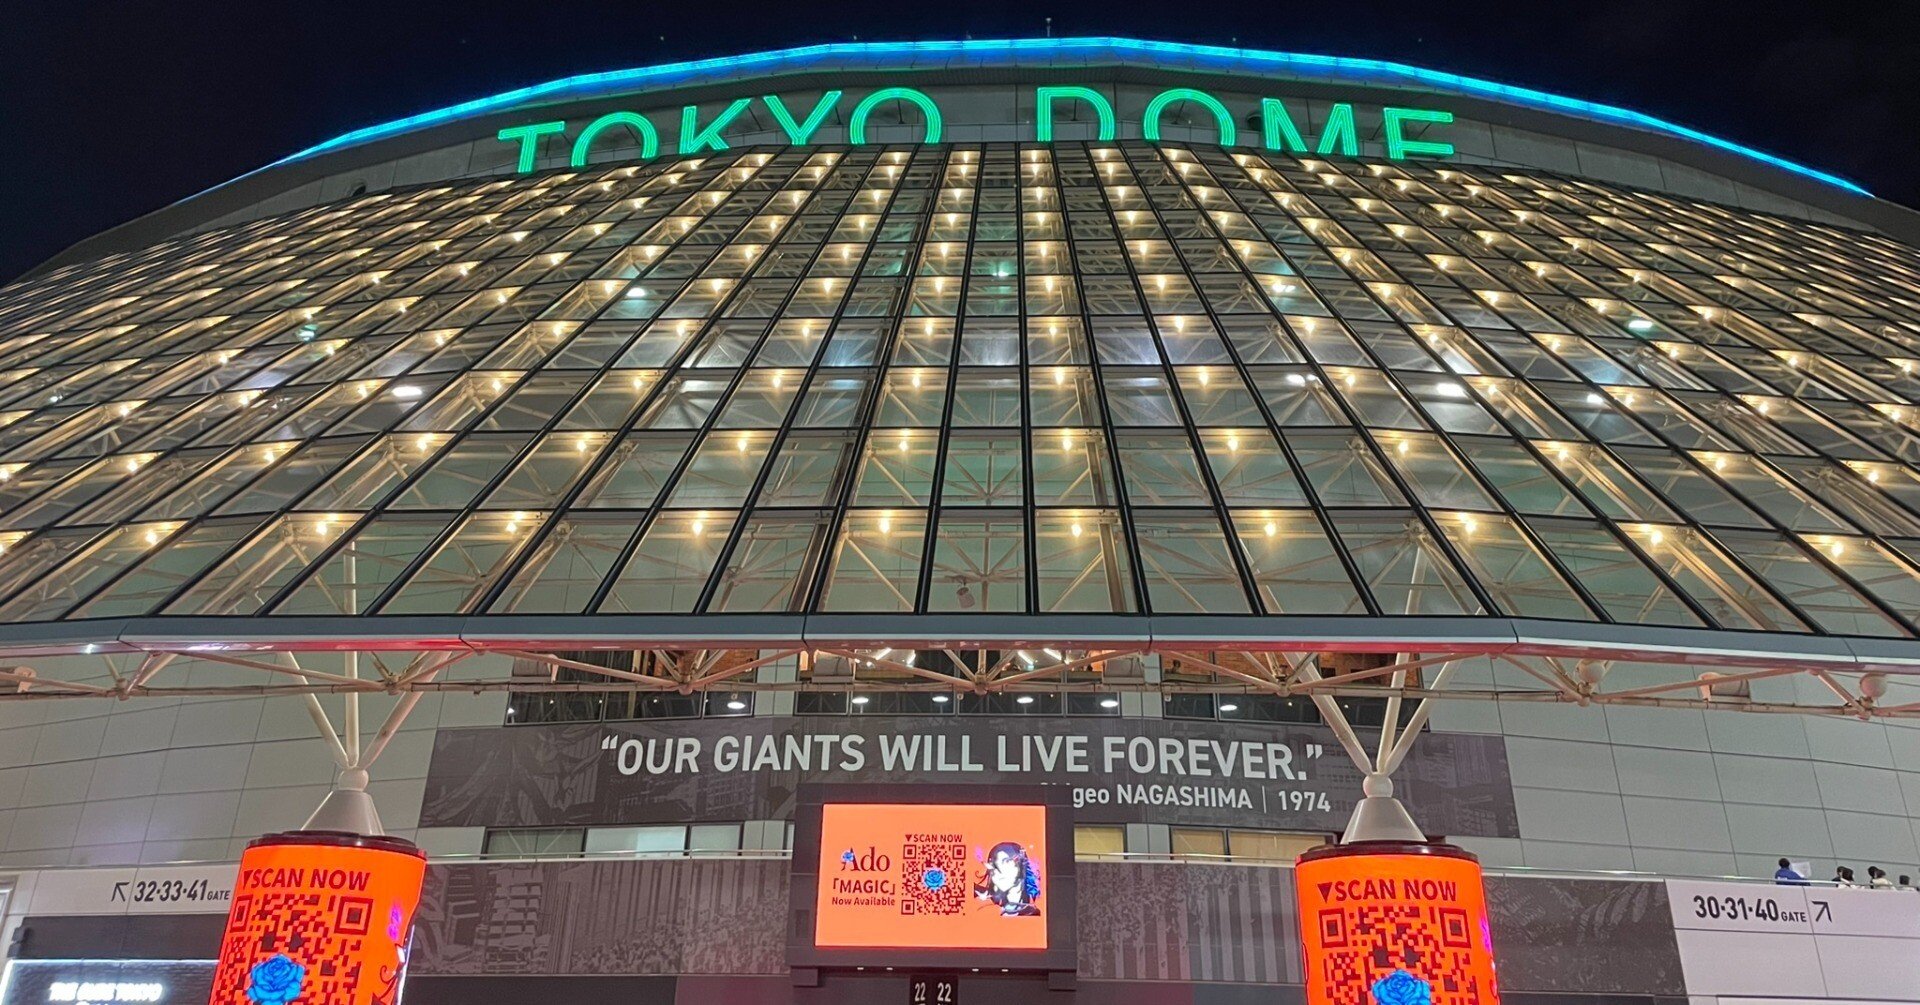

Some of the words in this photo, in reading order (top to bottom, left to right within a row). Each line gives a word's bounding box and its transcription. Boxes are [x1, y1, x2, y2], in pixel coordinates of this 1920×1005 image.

[498, 87, 942, 173] TOKYO
[1037, 86, 1454, 160] DOME
[601, 733, 701, 775] “OUR
[713, 734, 866, 772] GIANTS
[879, 734, 984, 772] WILL
[997, 735, 1089, 772] LIVE
[1103, 736, 1323, 781] FOREVER.”
[1116, 783, 1253, 810] NAGASHIMA
[1278, 789, 1332, 813] 1974
[913, 834, 938, 843] SCAN
[939, 834, 963, 843] NOW
[841, 846, 891, 872] Ado
[250, 868, 302, 889] SCAN
[309, 869, 371, 892] NOW
[1334, 878, 1396, 901] SCAN
[1403, 878, 1457, 902] NOW
[207, 889, 231, 901] GATE
[831, 896, 852, 906] Now
[853, 896, 896, 906] Available
[1780, 911, 1808, 923] GATE
[914, 982, 926, 1002] 22
[937, 982, 952, 1003] 22
